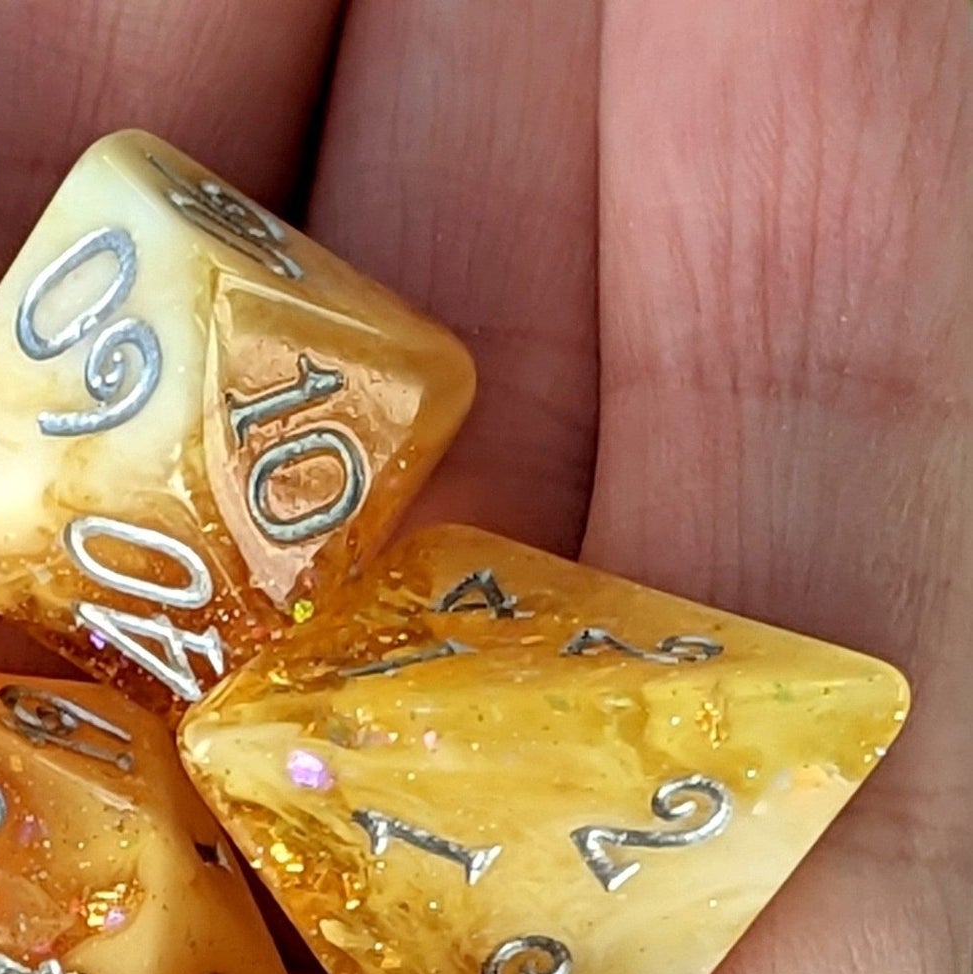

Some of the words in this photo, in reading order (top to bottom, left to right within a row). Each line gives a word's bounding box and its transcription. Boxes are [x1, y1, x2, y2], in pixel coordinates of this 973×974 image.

[227, 354, 371, 543] 10
[64, 516, 227, 700] 40
[352, 809, 502, 884] 1
[571, 774, 733, 891] 2
